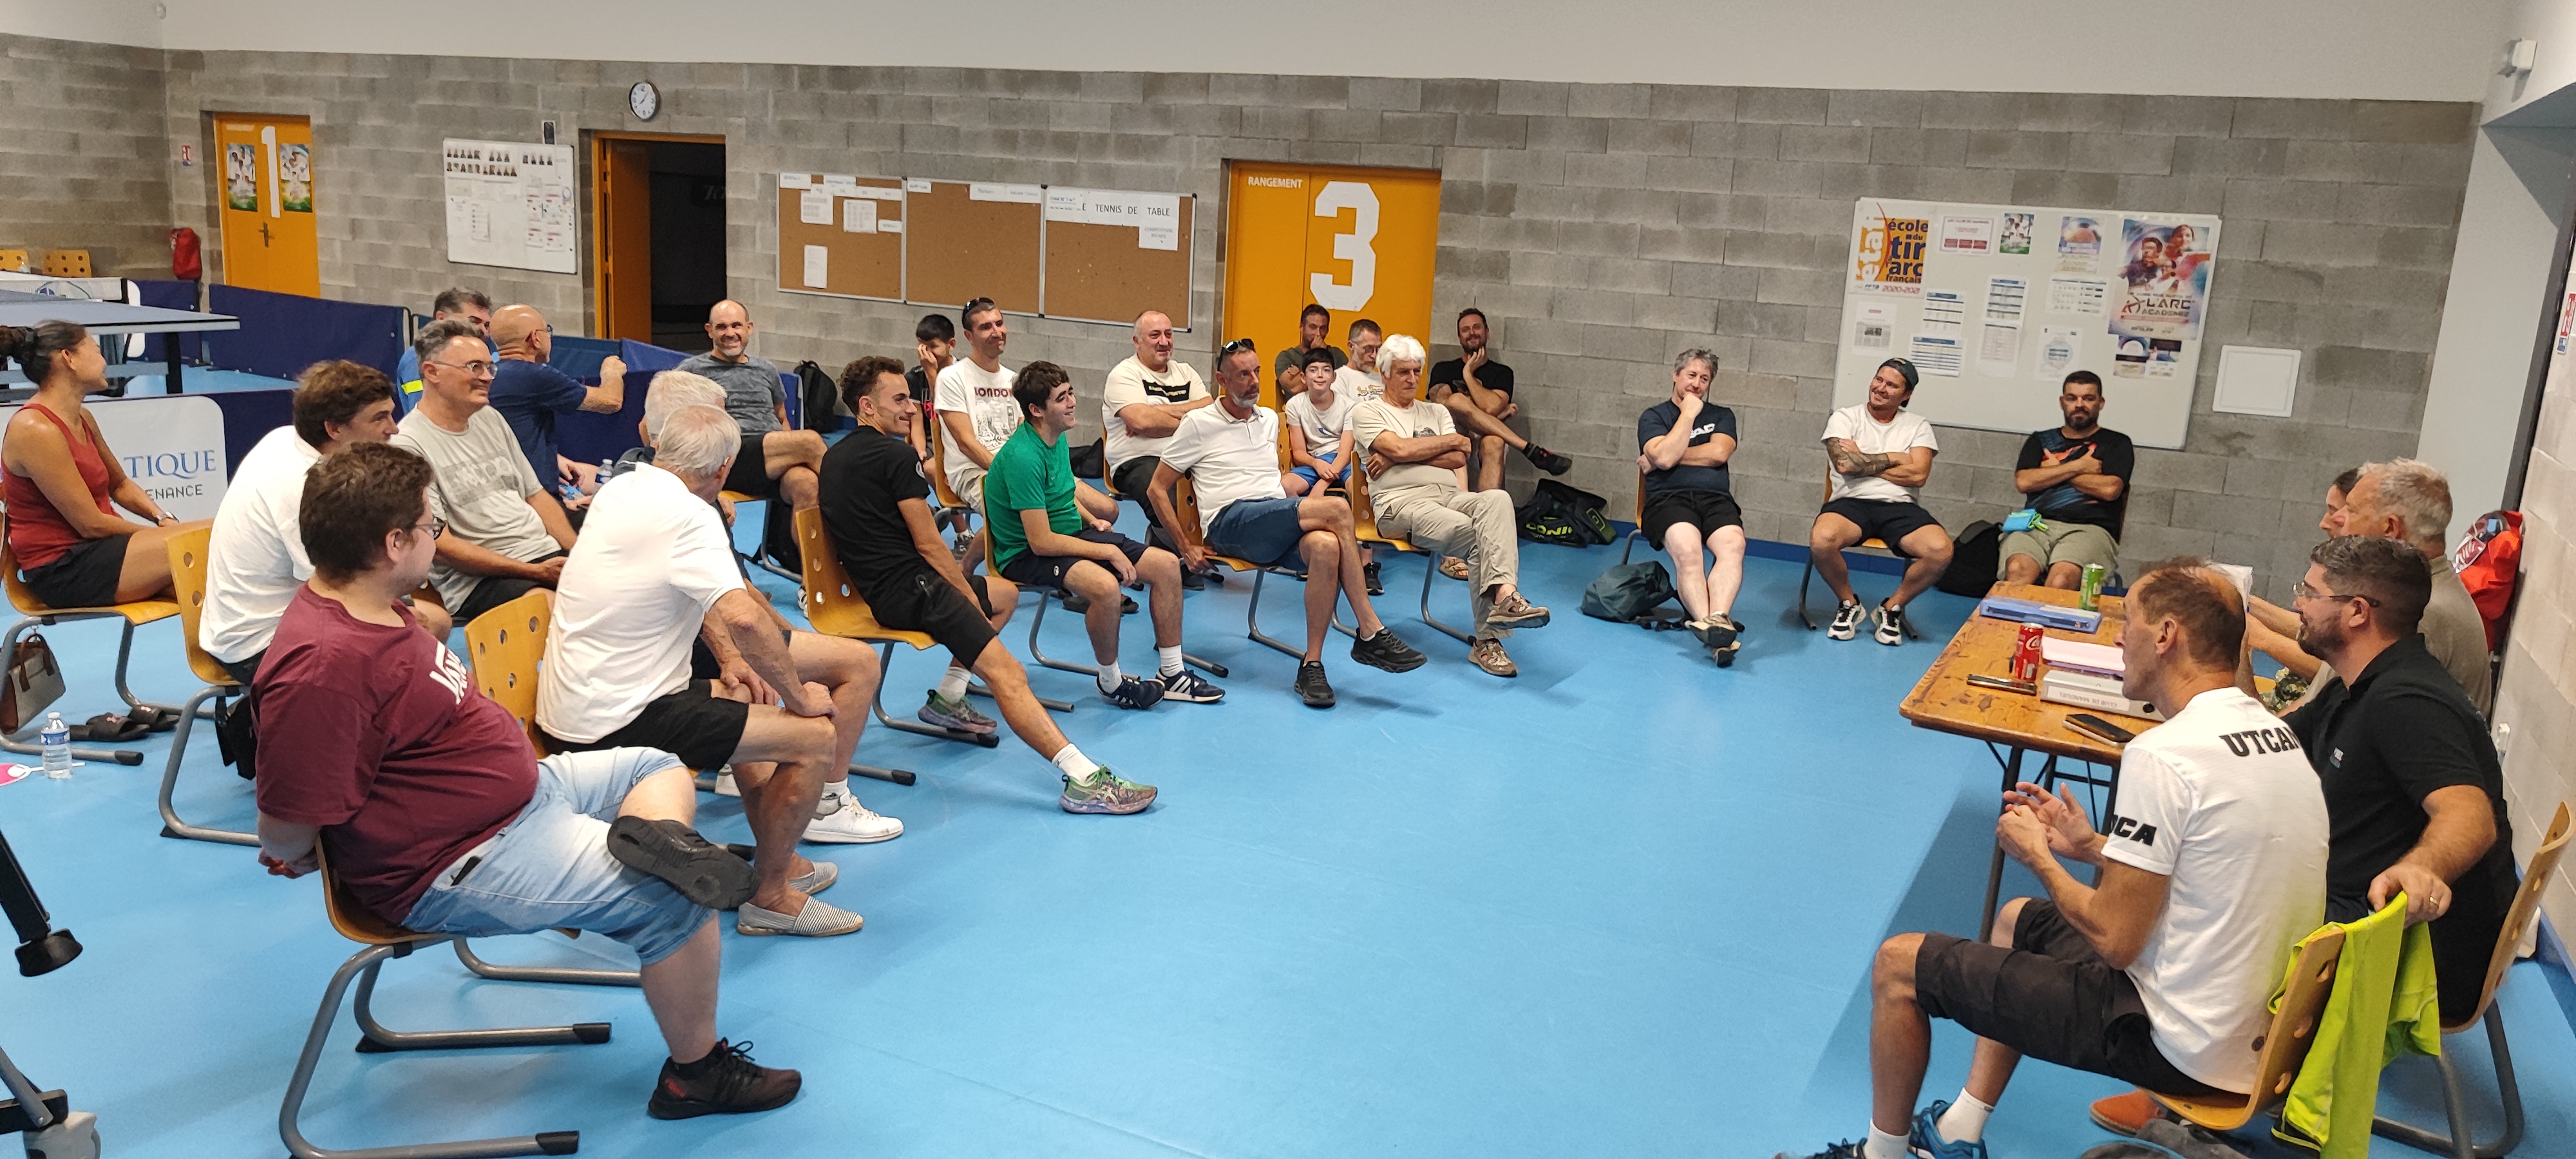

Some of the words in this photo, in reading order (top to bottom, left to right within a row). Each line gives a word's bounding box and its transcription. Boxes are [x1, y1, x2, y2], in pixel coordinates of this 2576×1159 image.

[261, 126, 281, 218] 1
[1248, 176, 1303, 189] RANGEMENT
[1095, 203, 1122, 213] TENNIS
[1128, 206, 1138, 214] DE
[1147, 207, 1170, 216] TABLE
[1888, 218, 1929, 232] école
[1310, 180, 1380, 312] 3
[1891, 236, 1926, 260] tir
[1888, 261, 1924, 277] arc
[1886, 273, 1922, 284] français
[124, 449, 216, 480] TIQUE
